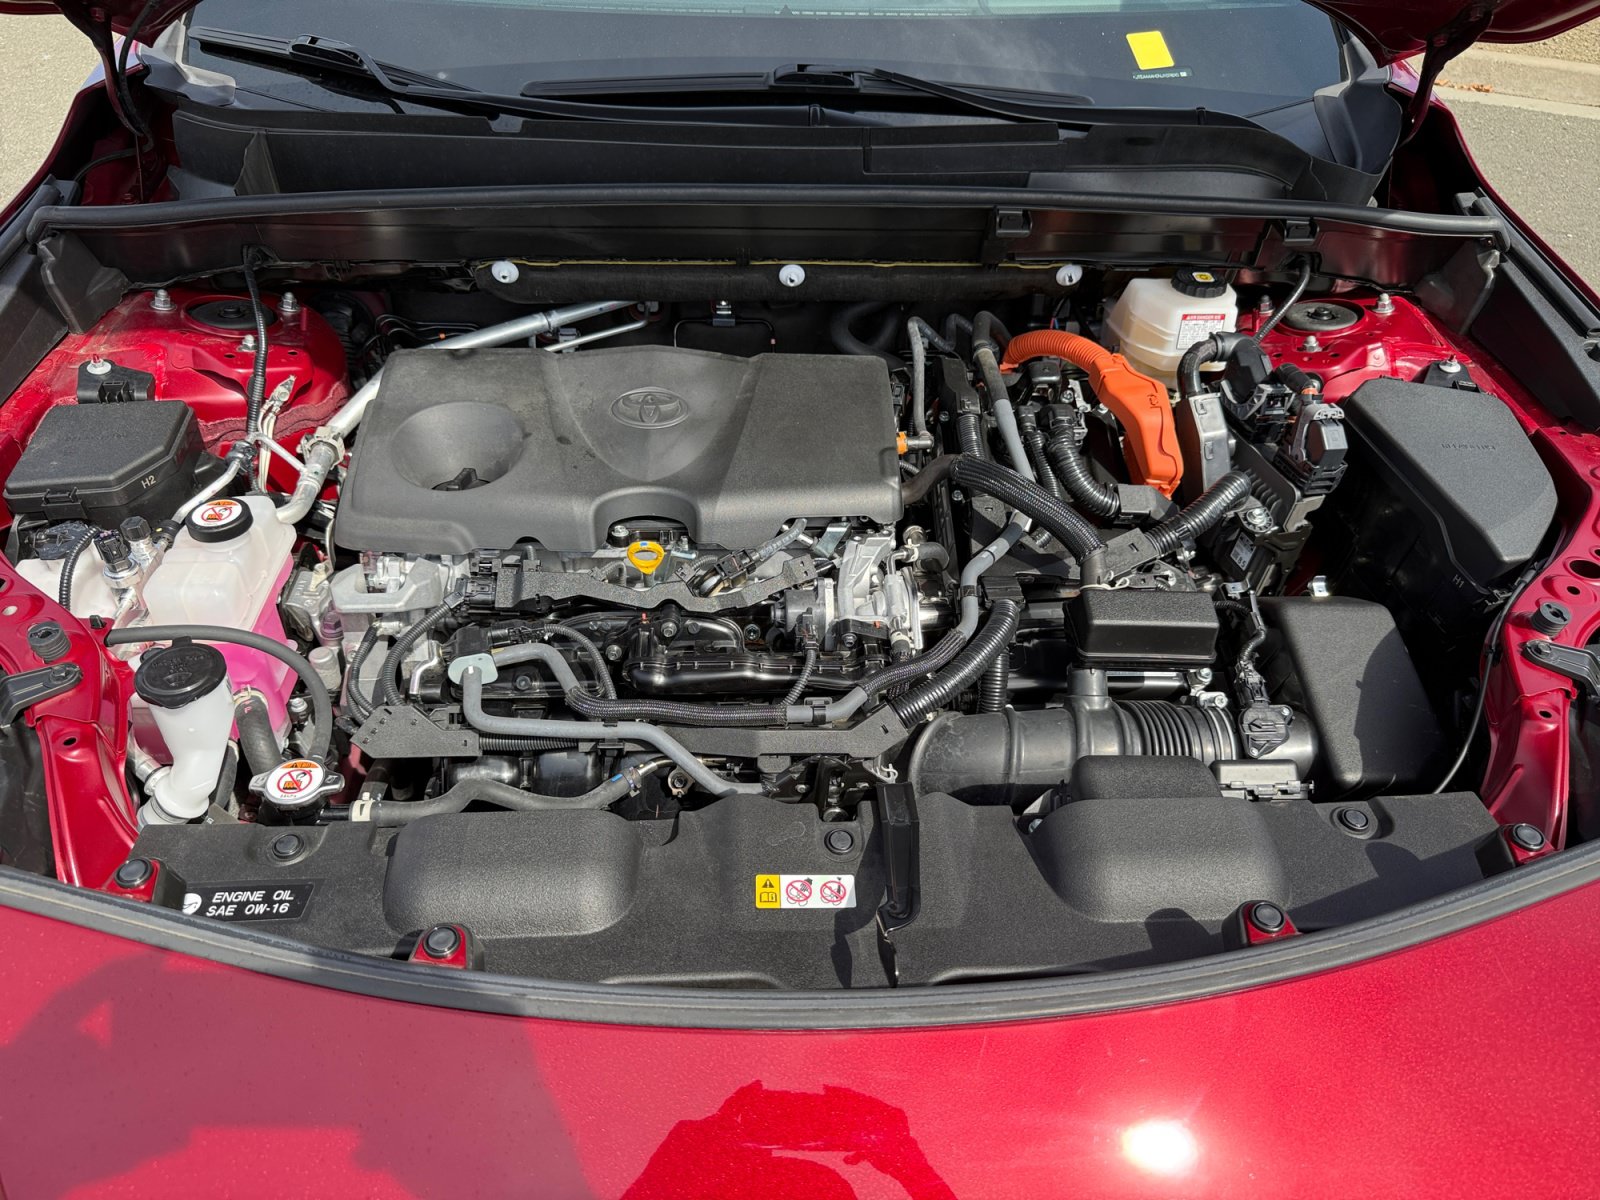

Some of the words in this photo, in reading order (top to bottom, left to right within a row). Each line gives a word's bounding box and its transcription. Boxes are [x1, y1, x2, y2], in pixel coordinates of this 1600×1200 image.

[141, 475, 156, 489] H2
[1453, 574, 1464, 588] H1
[212, 890, 266, 903] ENGINE
[273, 889, 294, 900] OIL
[205, 904, 237, 917] SAE
[244, 902, 290, 915] 0W-16
